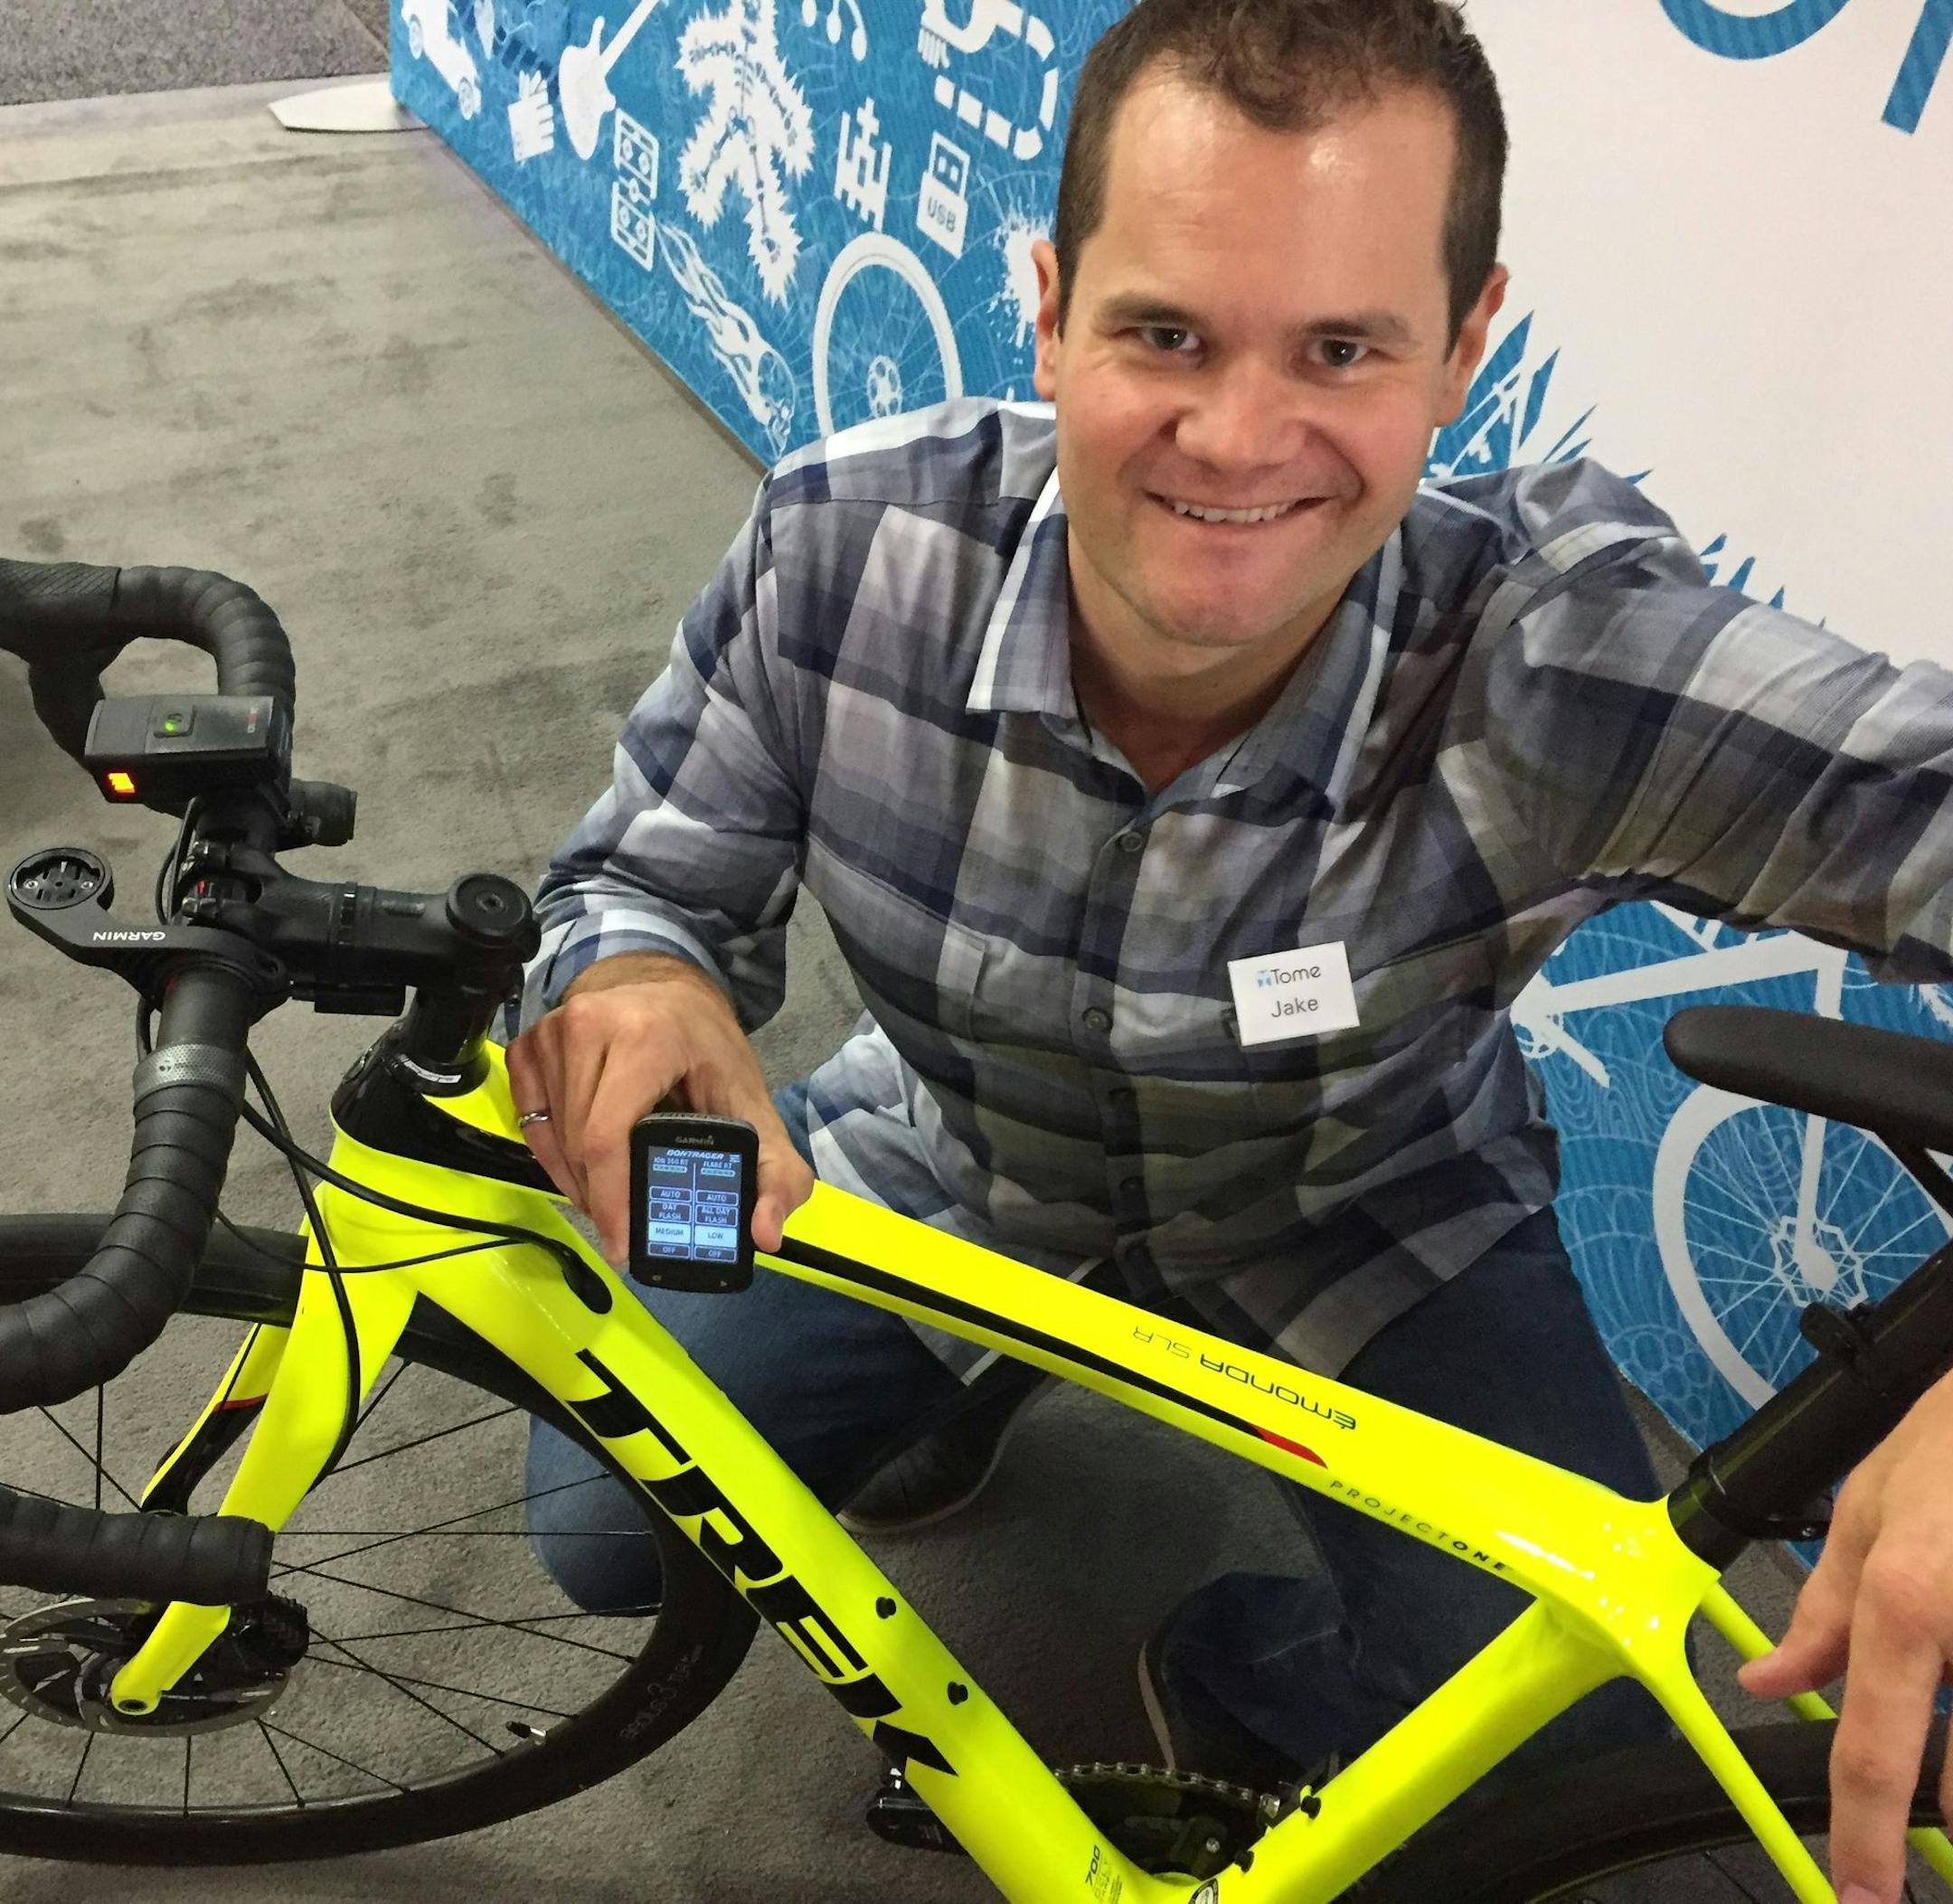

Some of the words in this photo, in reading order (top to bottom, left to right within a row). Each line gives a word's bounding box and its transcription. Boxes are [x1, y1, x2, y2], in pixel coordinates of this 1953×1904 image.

[928, 195, 956, 232] USB
[93, 931, 165, 941] GARMIN
[1270, 966, 1322, 985] Tome
[1271, 997, 1319, 1018] Jake
[675, 1136, 715, 1145] GARMIN
[666, 1149, 725, 1160] BONTRAGER
[660, 1190, 681, 1199] AUTO
[706, 1193, 727, 1202] AUTO
[658, 1212, 682, 1221] FLASH
[704, 1216, 728, 1224] FLASH
[707, 1231, 724, 1239] LOW
[1133, 1326, 1193, 1359] SLR
[566, 1348, 959, 1777] TREK
[1085, 1844, 1100, 1886] 700
